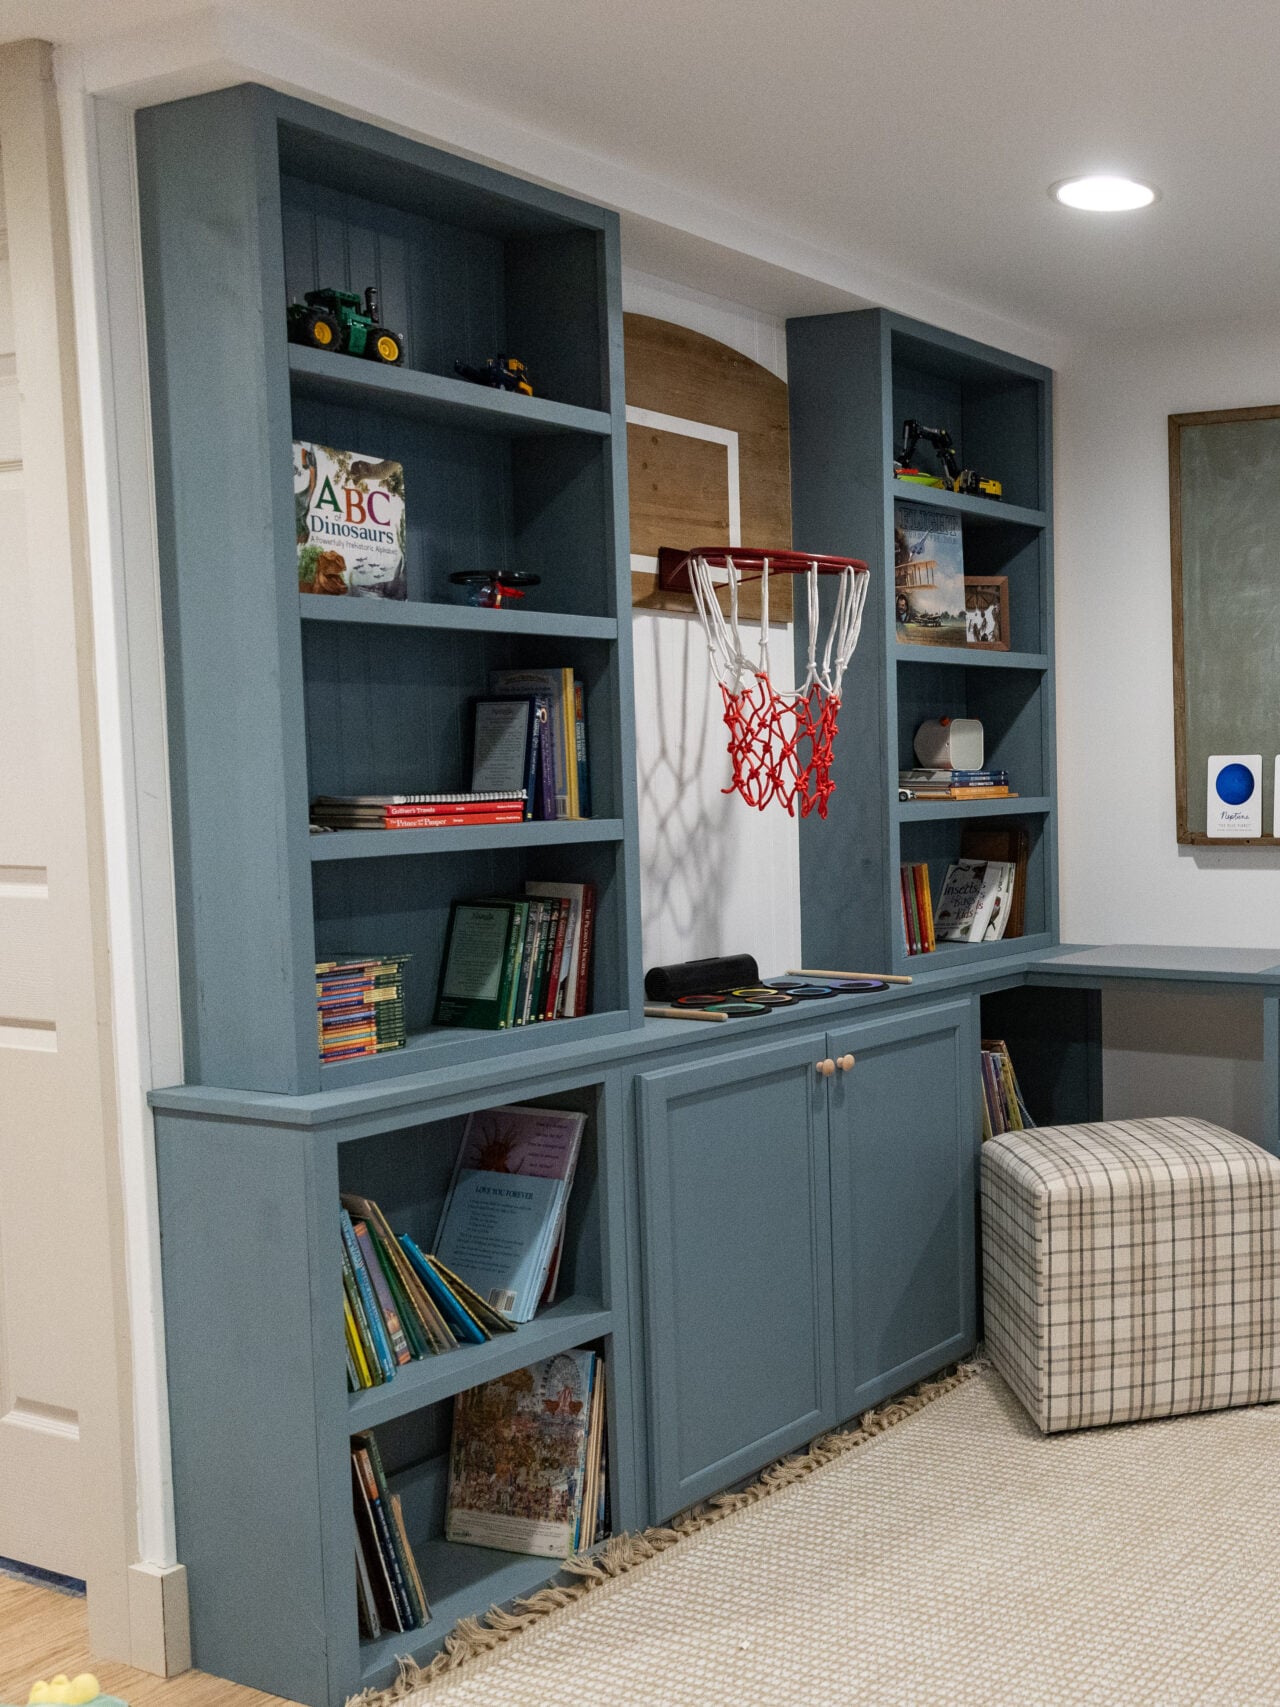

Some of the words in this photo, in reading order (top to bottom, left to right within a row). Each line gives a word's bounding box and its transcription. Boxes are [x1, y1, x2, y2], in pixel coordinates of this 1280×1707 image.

[314, 474, 391, 527] ABC
[334, 513, 342, 521] of
[310, 515, 394, 545] Dinosaurs
[1220, 811, 1250, 820] Neptune
